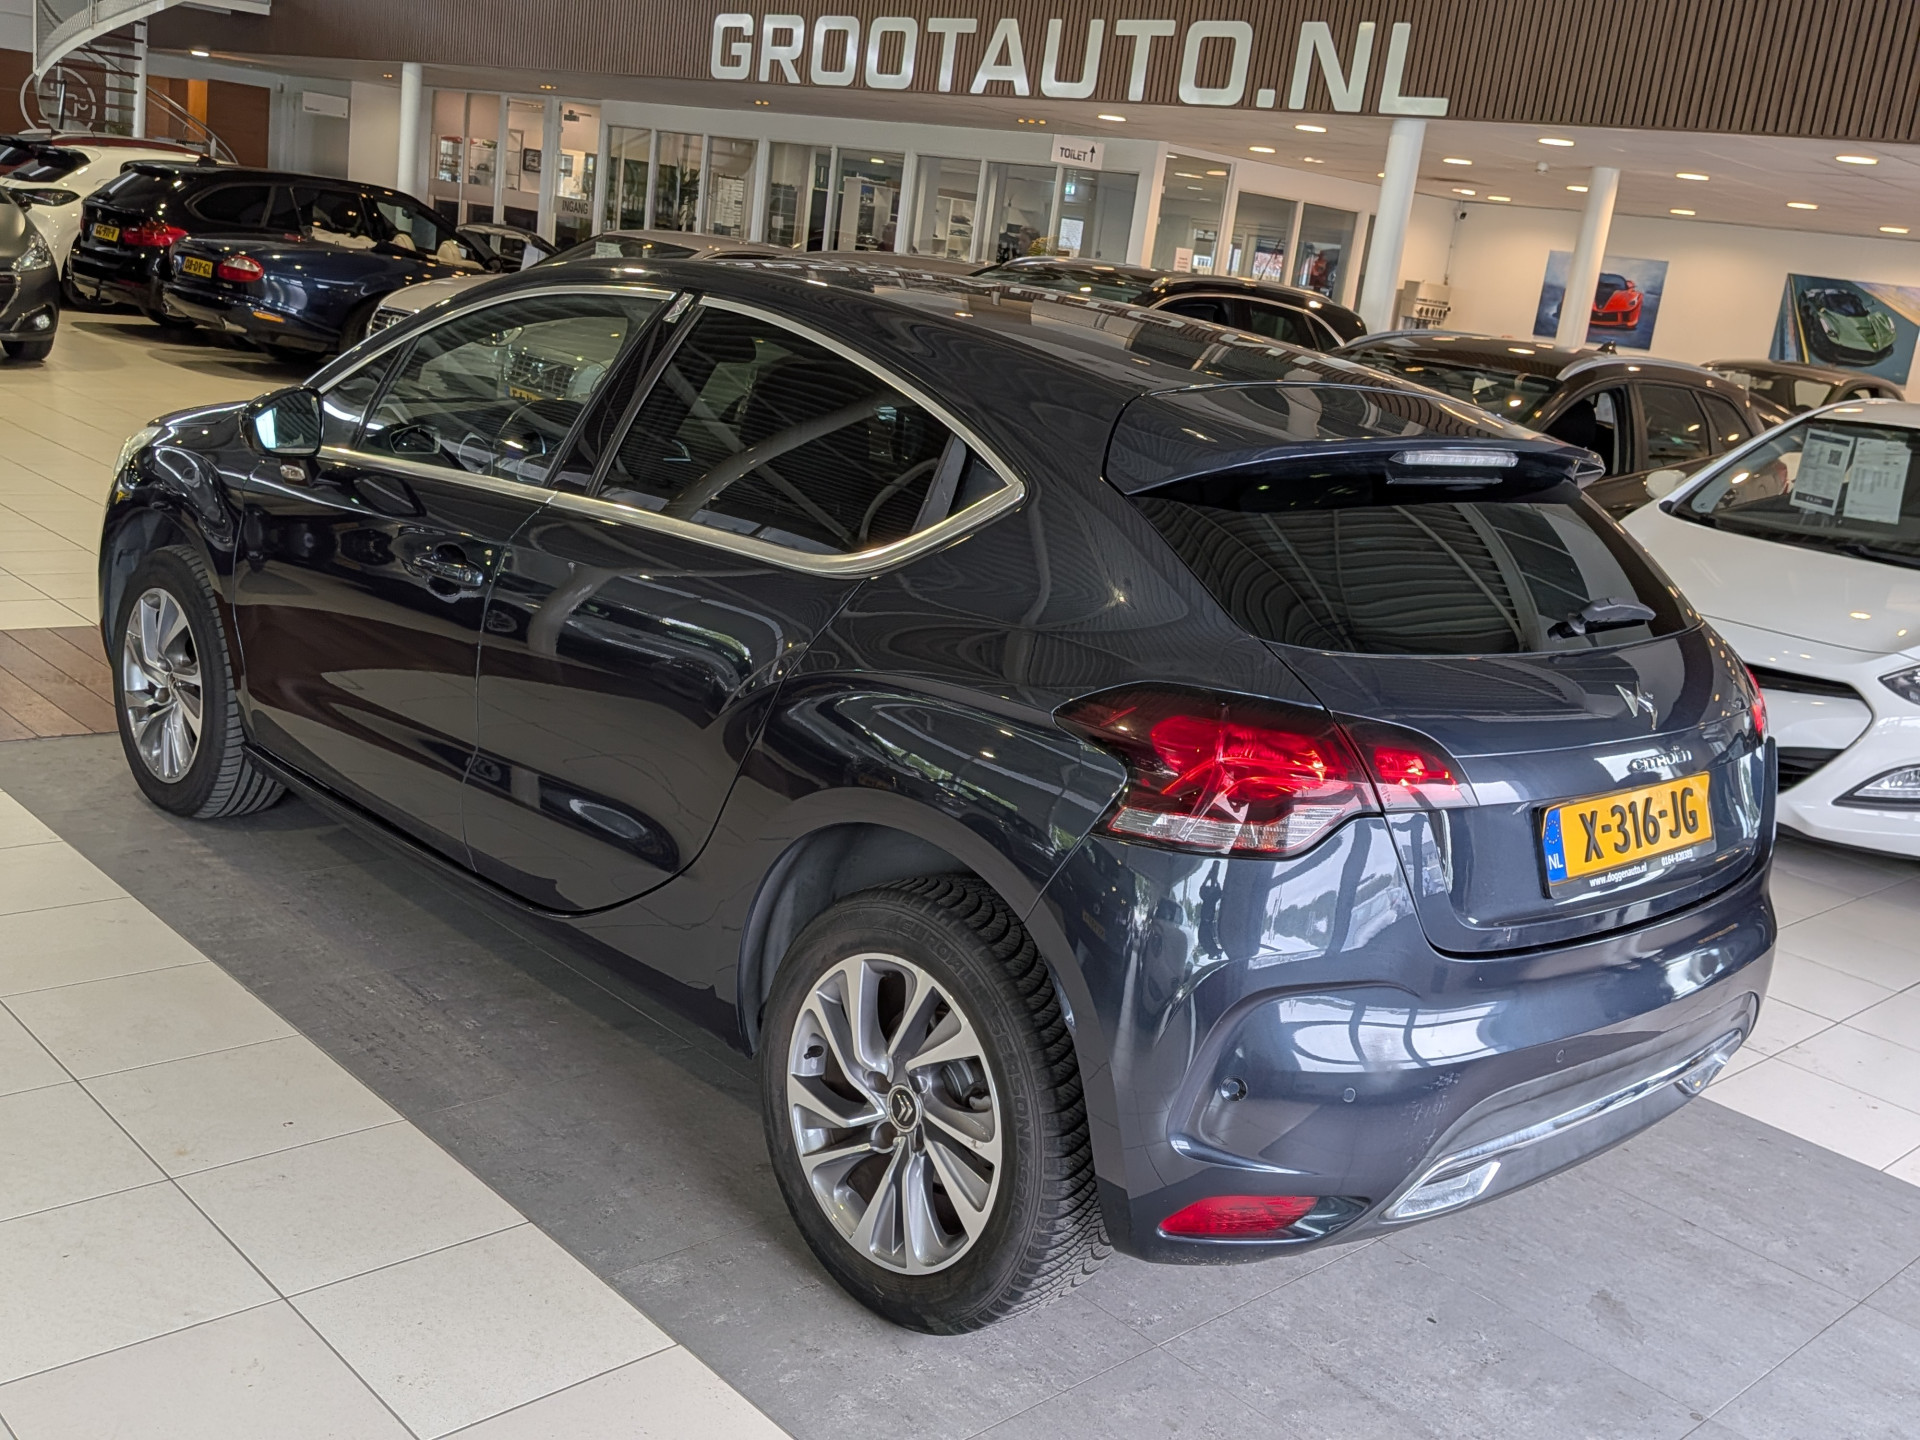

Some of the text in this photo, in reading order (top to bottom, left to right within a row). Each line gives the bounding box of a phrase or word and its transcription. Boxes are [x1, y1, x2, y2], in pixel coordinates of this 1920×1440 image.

[710, 12, 1449, 117] GROOTAUTO.NL
[1060, 146, 1088, 162] TOILET
[561, 200, 589, 215] INGANG
[1578, 787, 1699, 863] X-316-JG
[1548, 853, 1564, 871] NL
[1589, 862, 1648, 887] www.doggenauto.nl
